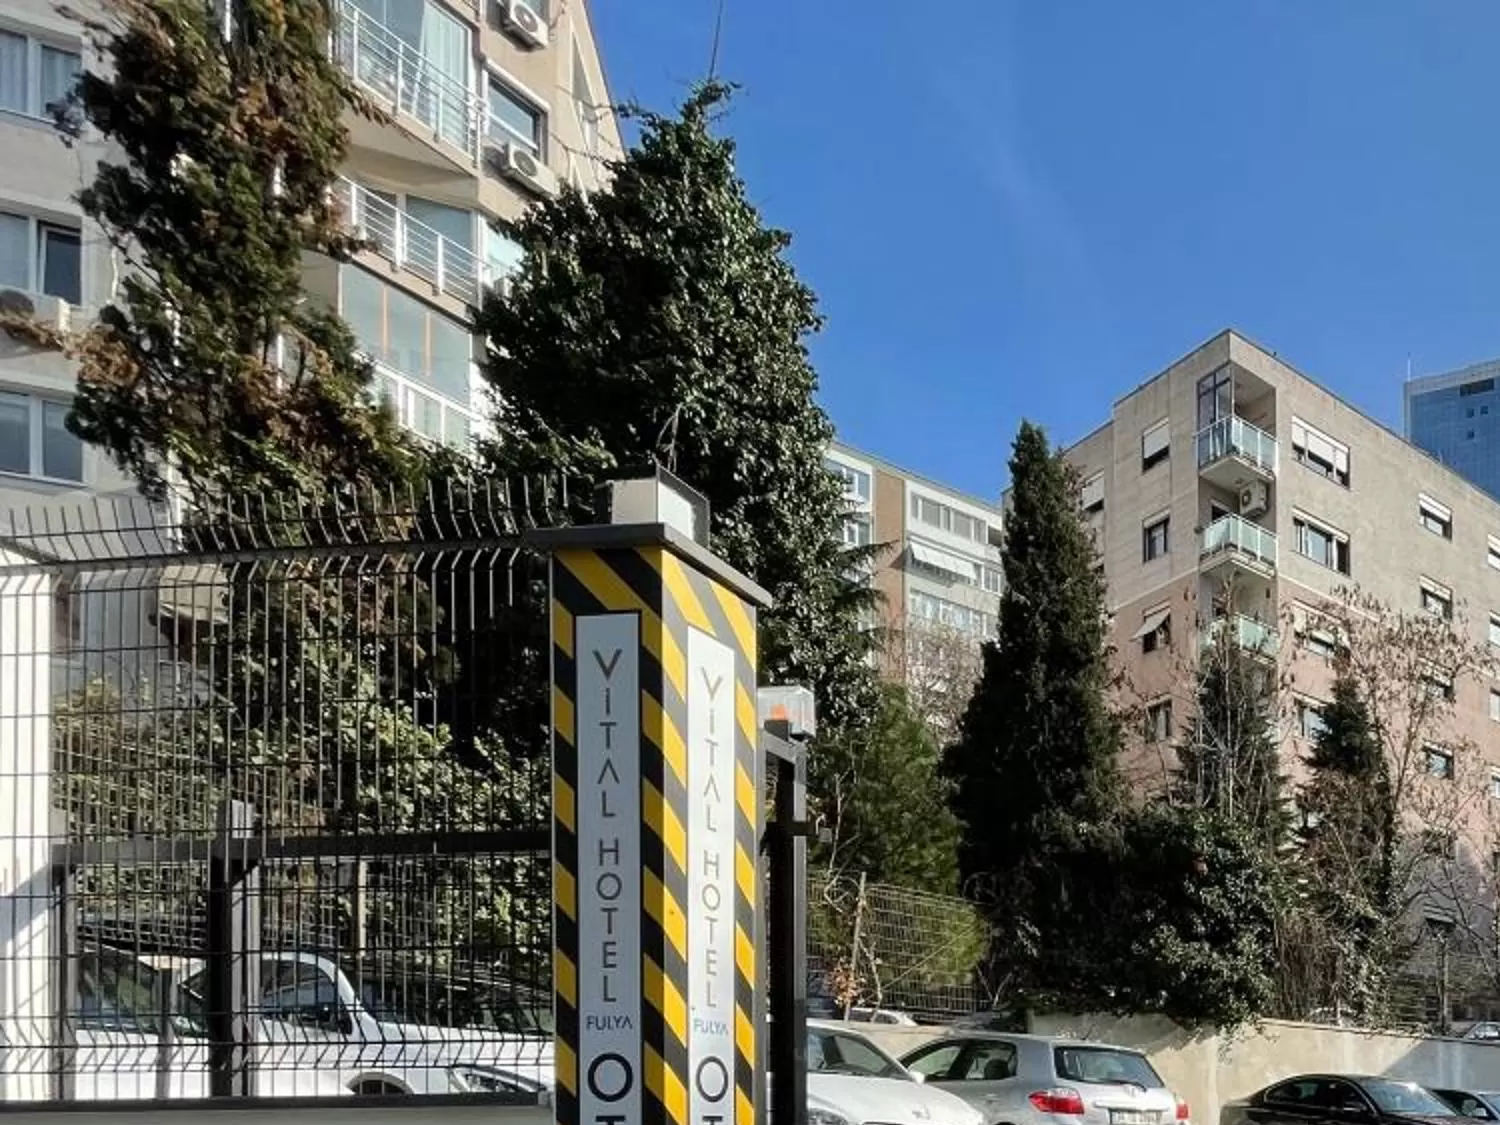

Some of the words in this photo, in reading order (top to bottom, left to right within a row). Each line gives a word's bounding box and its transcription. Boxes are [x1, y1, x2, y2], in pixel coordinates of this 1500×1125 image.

[592, 648, 622, 818] VITAL
[701, 666, 723, 832] VITAL
[597, 838, 623, 1003] HOTEL
[702, 851, 721, 1009] HOTEL
[586, 1015, 633, 1031] FULYA
[694, 1018, 729, 1034] FULYA
